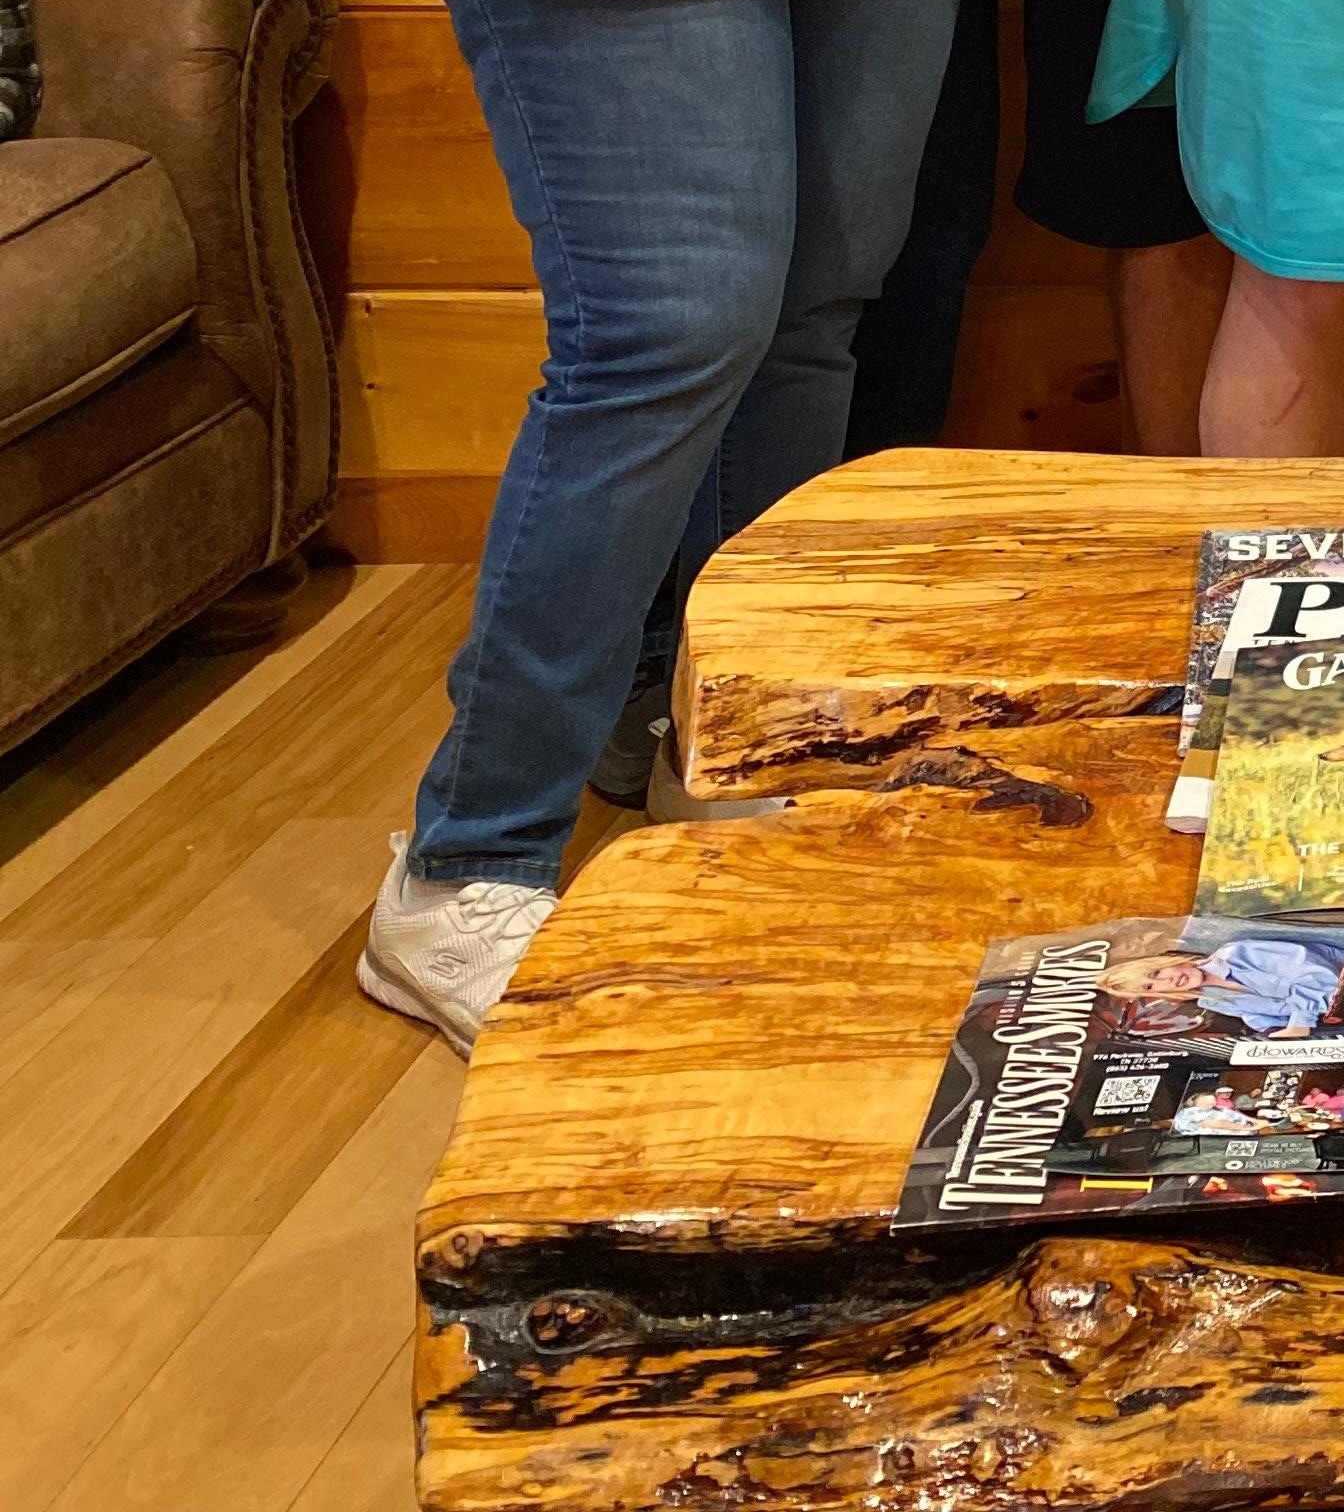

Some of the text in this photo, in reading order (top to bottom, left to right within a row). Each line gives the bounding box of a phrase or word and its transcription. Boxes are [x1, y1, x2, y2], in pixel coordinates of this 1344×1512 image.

[1298, 841, 1341, 857] THE
[939, 940, 1111, 1211] TENNESSEE SMOKIES
